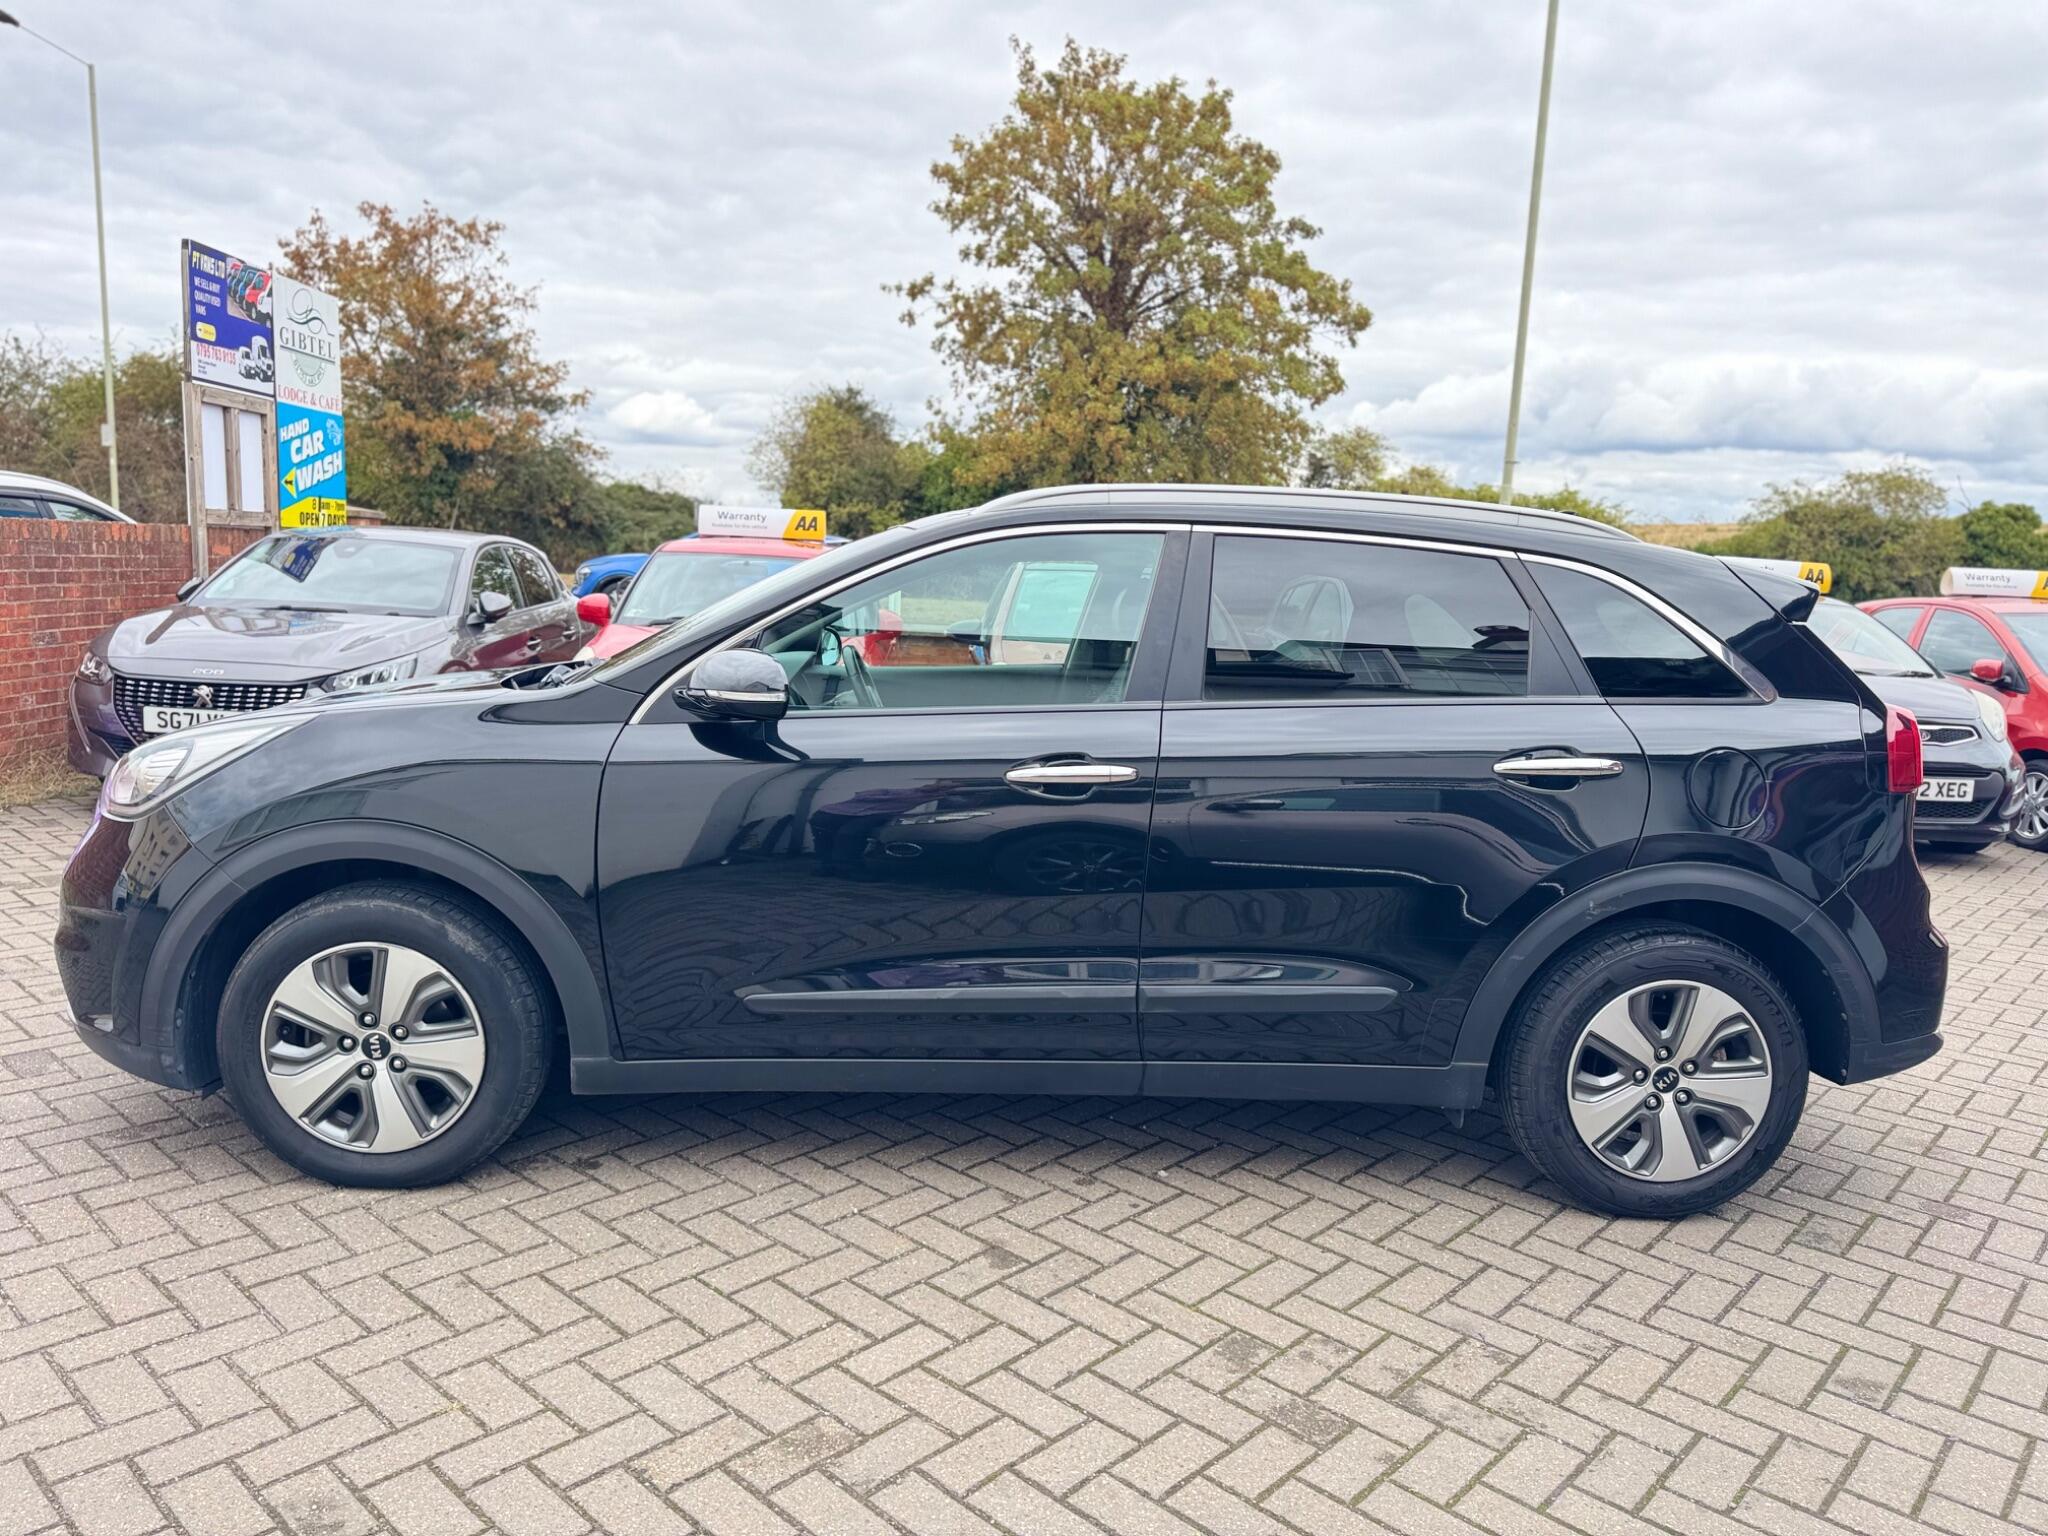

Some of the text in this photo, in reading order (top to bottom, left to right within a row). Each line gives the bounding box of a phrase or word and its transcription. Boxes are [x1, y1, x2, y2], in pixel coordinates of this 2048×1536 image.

[192, 250, 200, 269] PT
[280, 326, 335, 359] GIBTEL
[278, 384, 308, 404] LODGE
[309, 392, 317, 406] &
[280, 418, 310, 442] HAND
[290, 430, 325, 464] CAR
[296, 449, 343, 491] WASH
[299, 511, 345, 527] OPEN 7 DAYS
[717, 511, 767, 523] Warranty
[794, 515, 818, 532] AA
[1805, 568, 1824, 584] AA
[1965, 573, 2010, 583] Warranty
[1934, 782, 1968, 798] XEG
[369, 1034, 382, 1058] KIA
[1655, 1071, 1678, 1090] KIA
